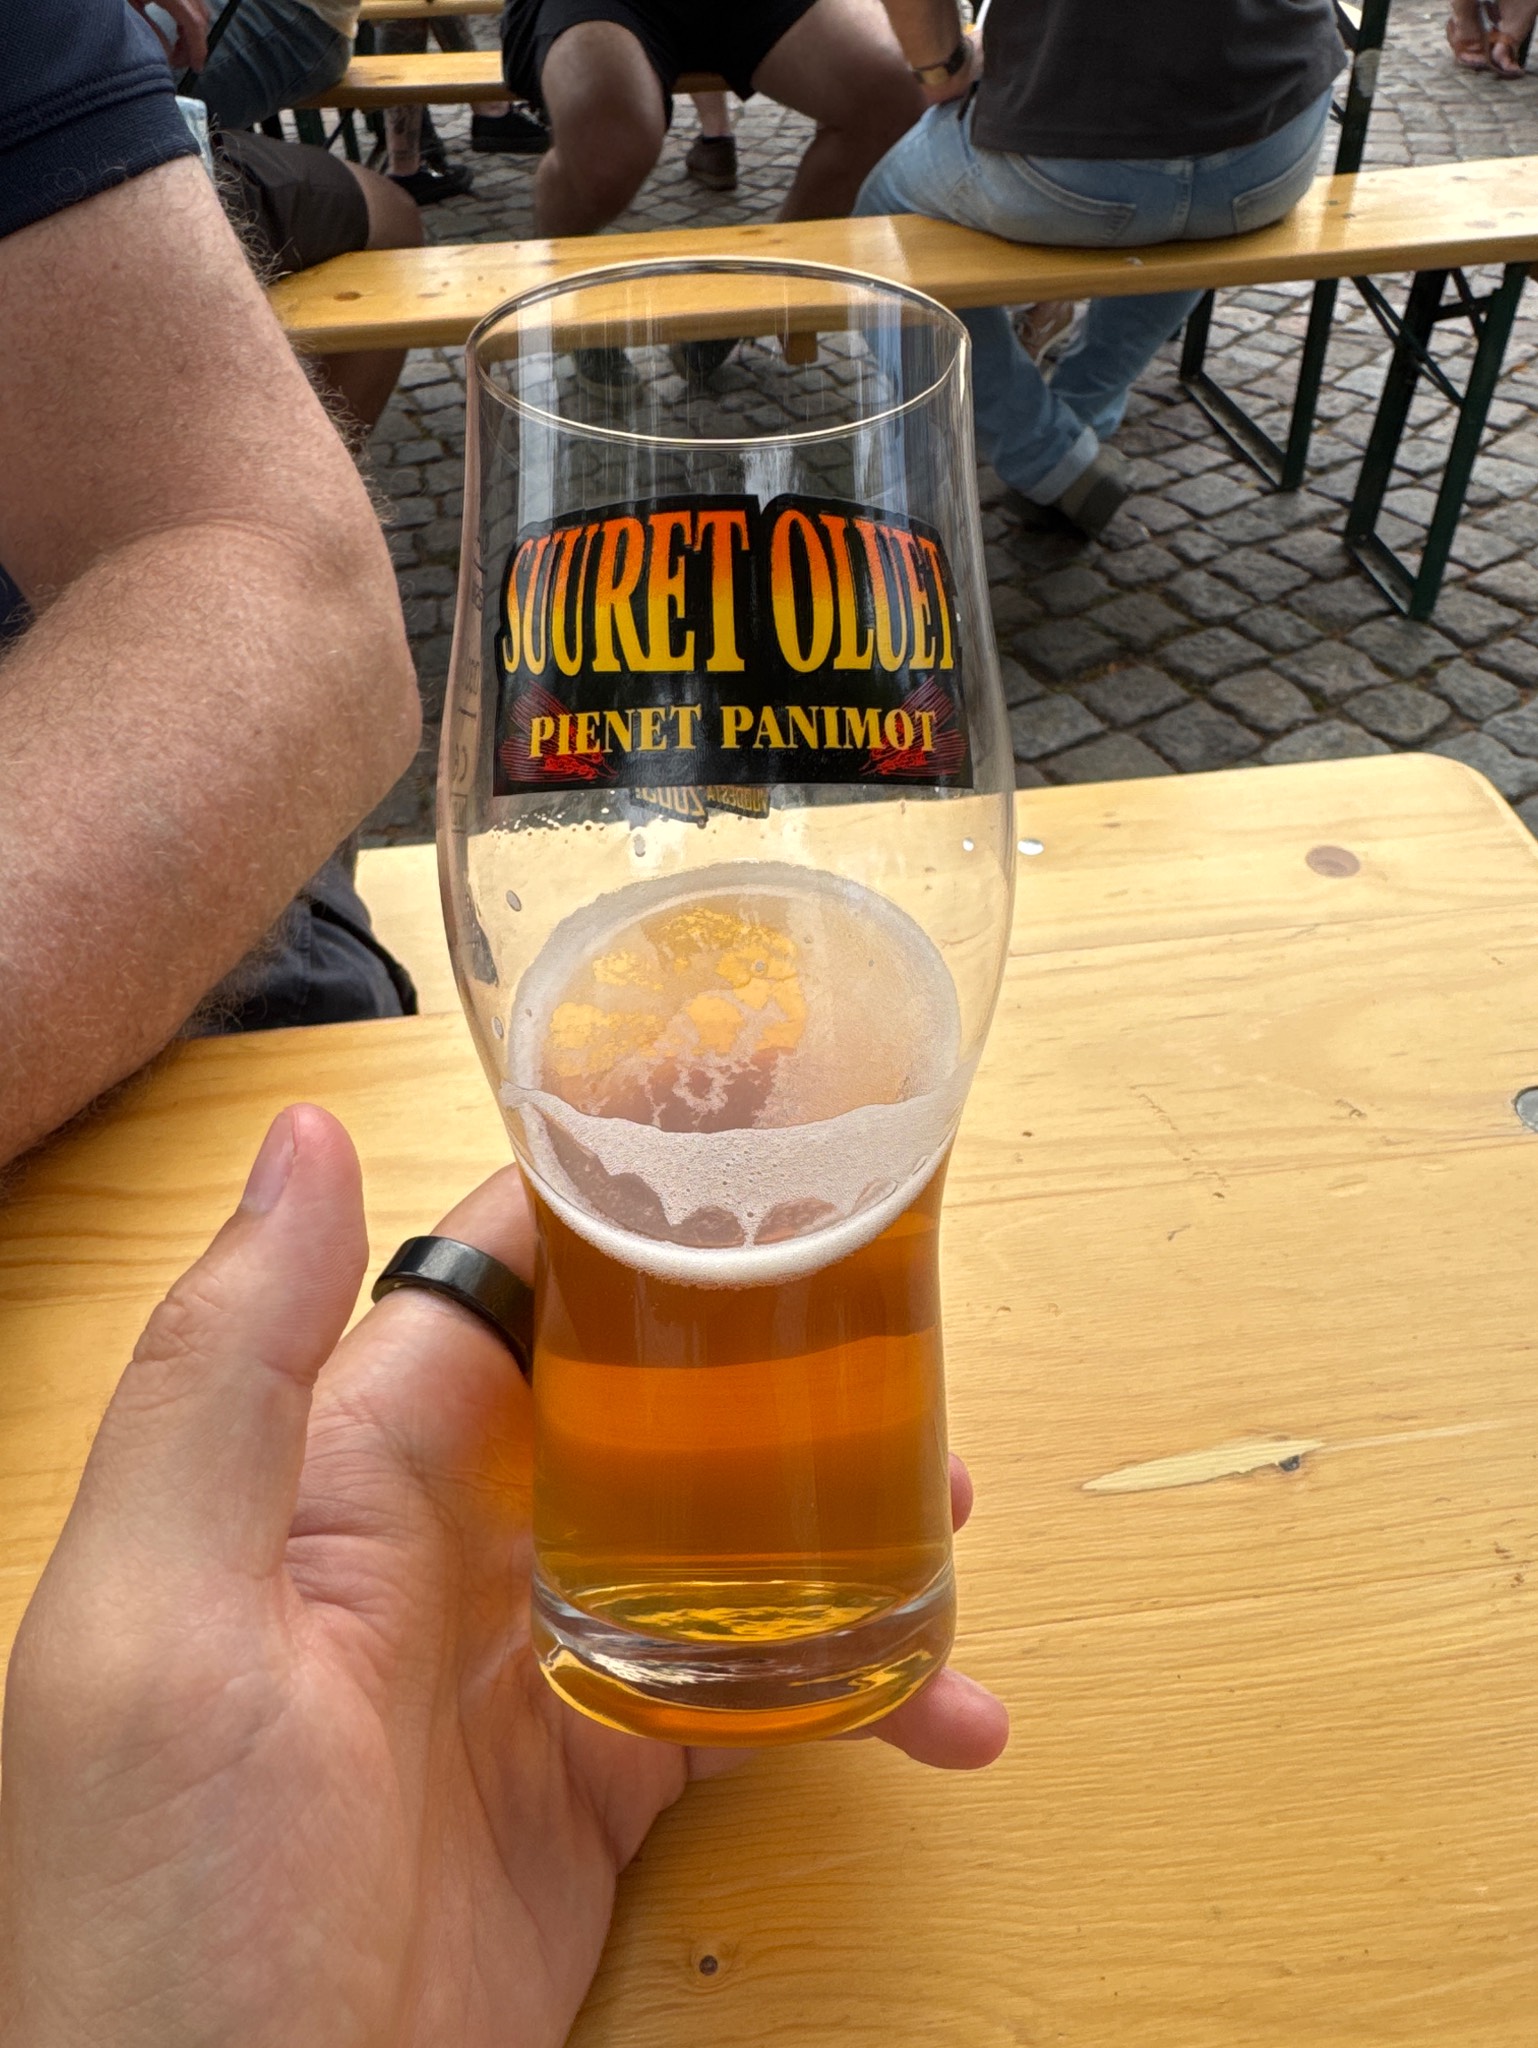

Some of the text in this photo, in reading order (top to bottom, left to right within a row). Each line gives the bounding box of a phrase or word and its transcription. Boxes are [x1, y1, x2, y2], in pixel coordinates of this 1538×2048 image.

[502, 509, 955, 676] SUURET OLUET
[528, 703, 938, 759] PIENET PANIMOT
